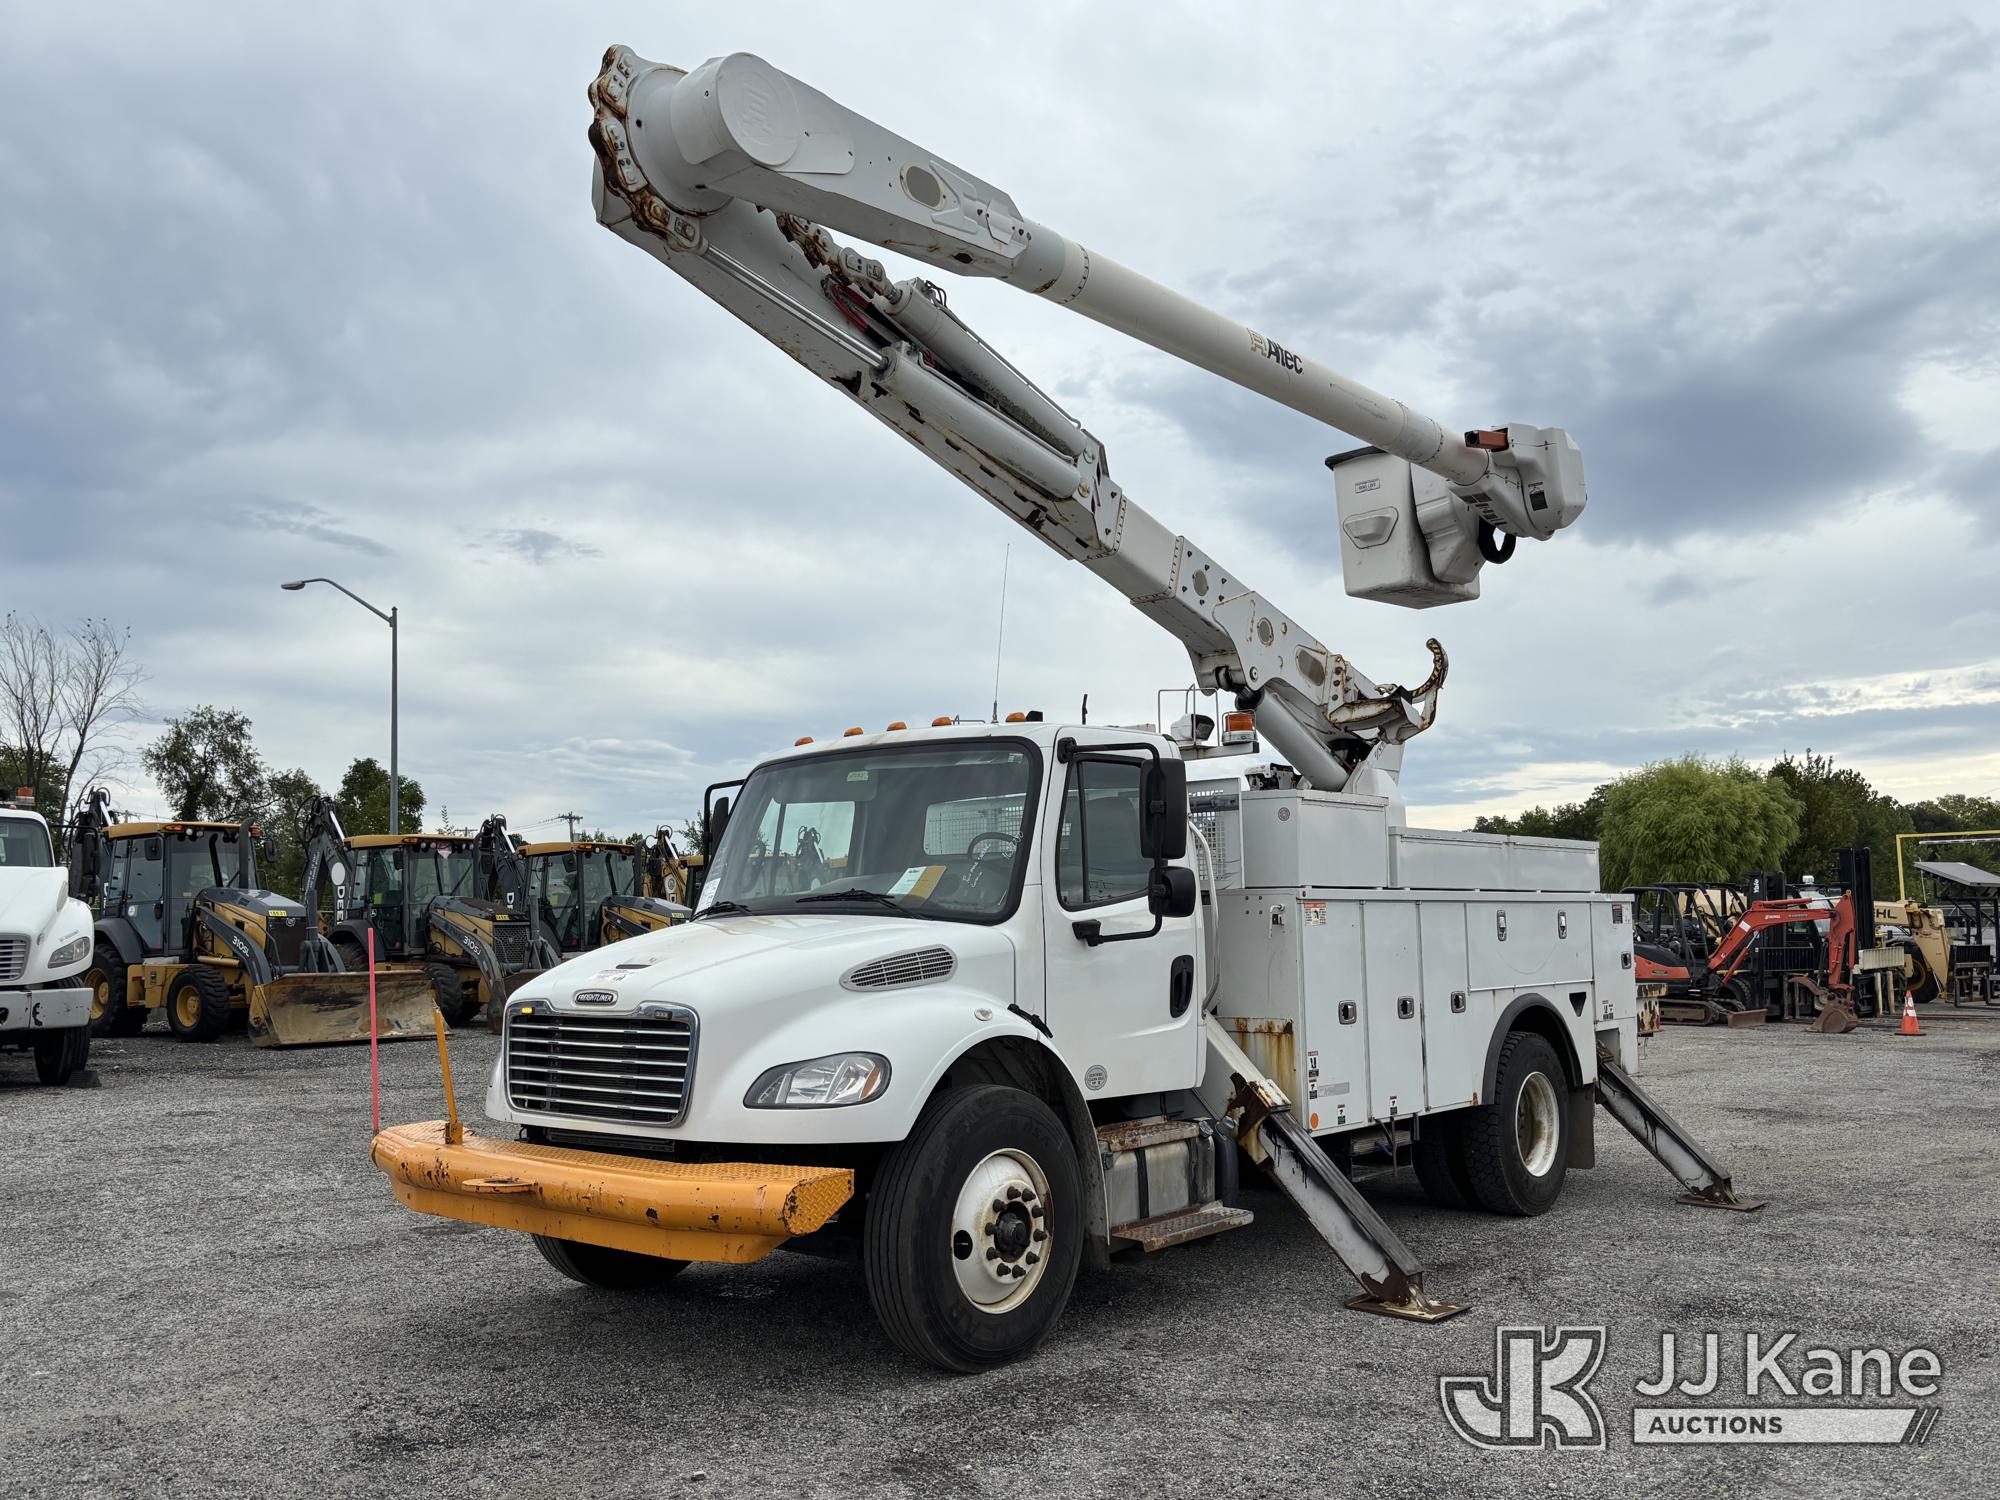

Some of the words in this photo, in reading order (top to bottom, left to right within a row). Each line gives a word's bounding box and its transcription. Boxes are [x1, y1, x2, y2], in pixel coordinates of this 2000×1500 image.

[1266, 337, 1303, 375] Altec
[1873, 906, 1898, 919] HL
[232, 935, 249, 957] 310SL
[463, 935, 482, 956] 310SJ
[577, 993, 613, 1002] FREIGHTLINER
